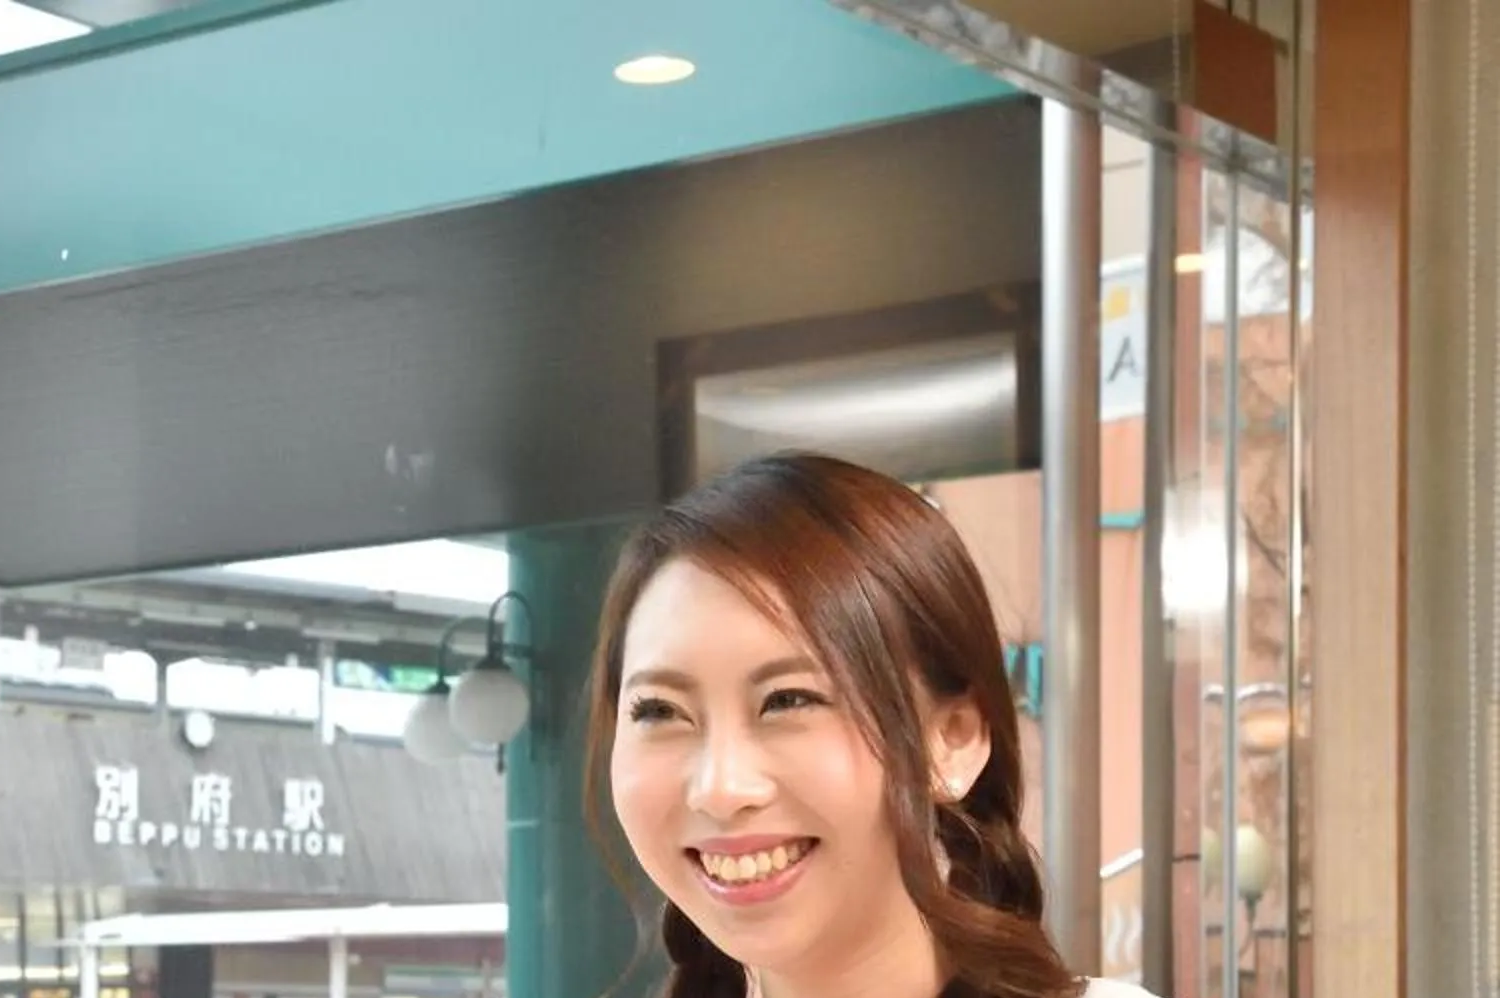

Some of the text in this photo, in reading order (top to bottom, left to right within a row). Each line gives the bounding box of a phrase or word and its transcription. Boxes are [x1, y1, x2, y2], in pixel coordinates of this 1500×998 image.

[95, 763, 325, 832] 別府駅
[93, 817, 345, 857] BEPPU STATION
